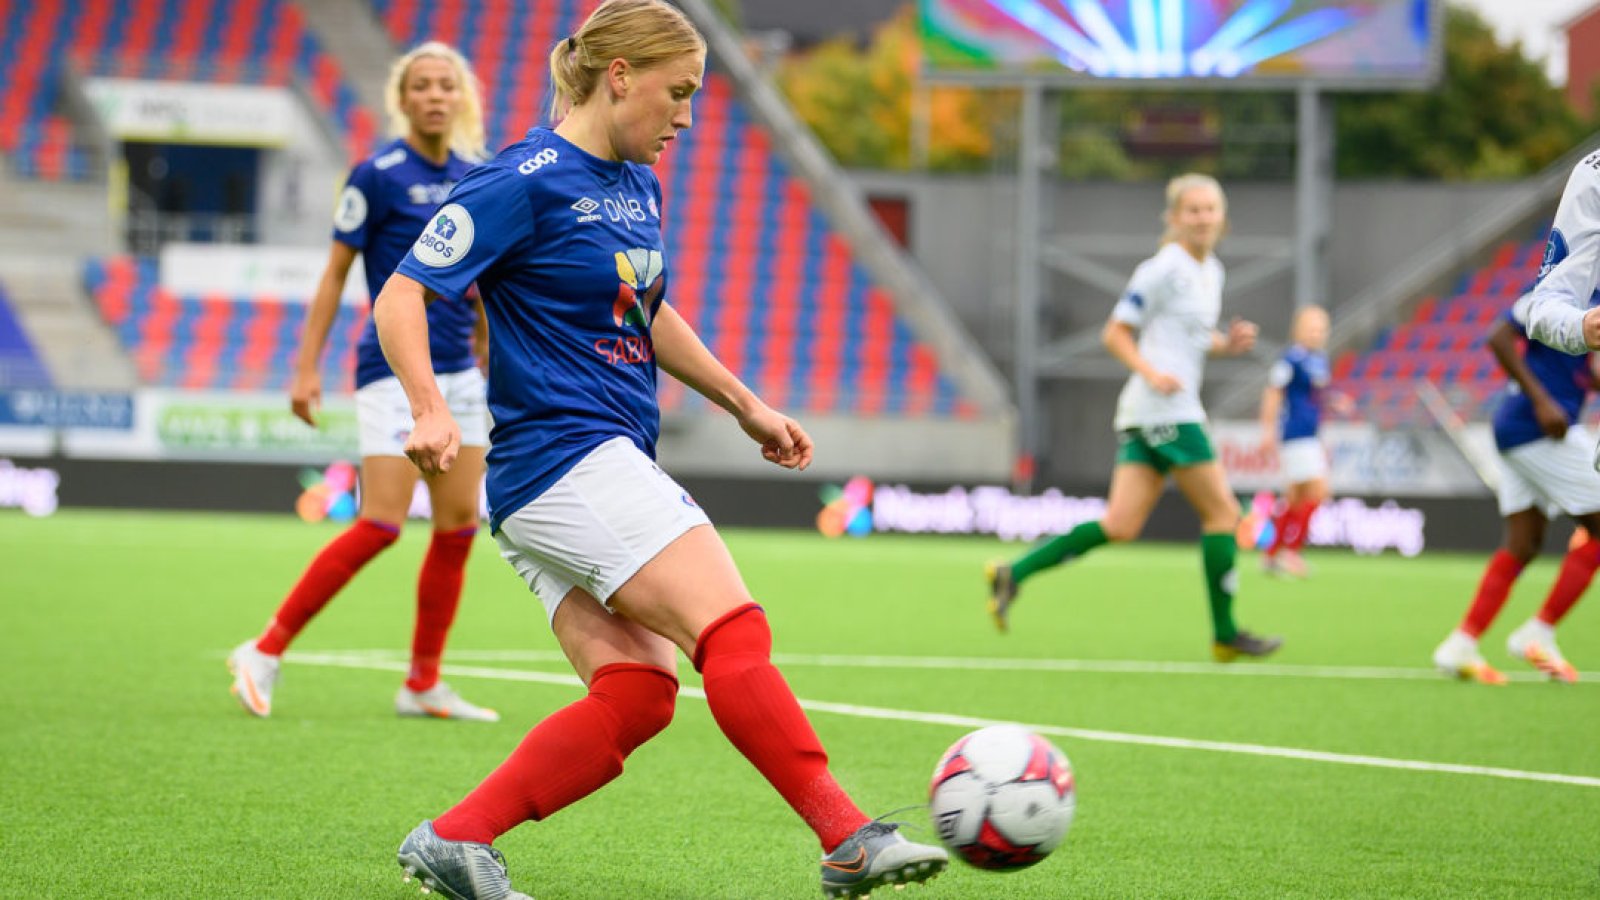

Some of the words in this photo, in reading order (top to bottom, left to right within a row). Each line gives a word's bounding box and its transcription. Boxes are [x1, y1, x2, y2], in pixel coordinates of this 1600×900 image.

[518, 148, 558, 175] coop
[576, 214, 602, 223] umbro
[604, 191, 646, 231] DNB
[420, 233, 454, 258] OBOS
